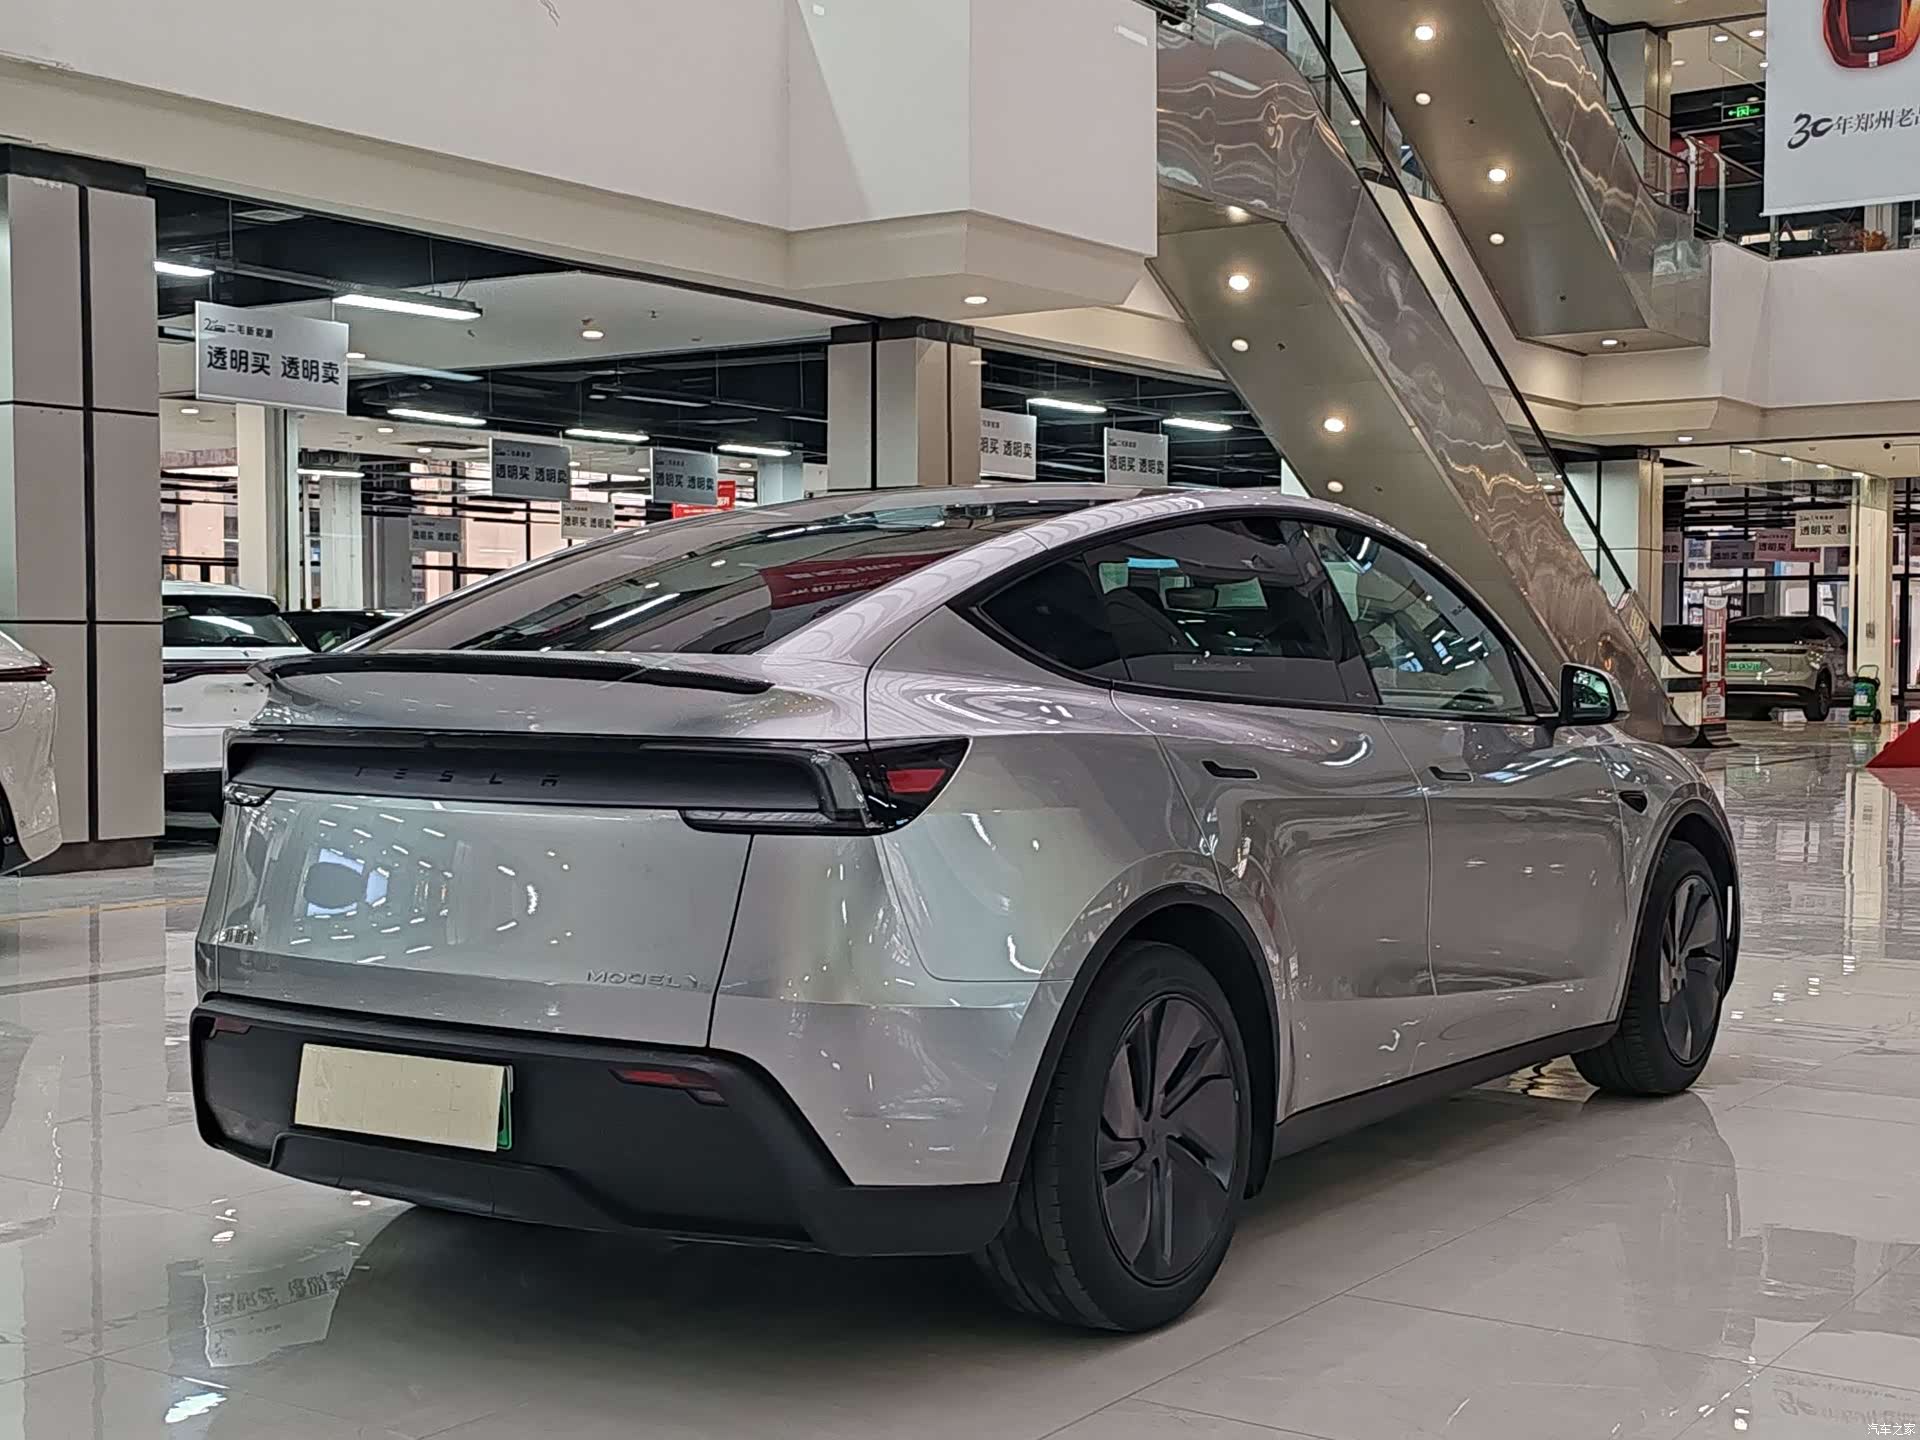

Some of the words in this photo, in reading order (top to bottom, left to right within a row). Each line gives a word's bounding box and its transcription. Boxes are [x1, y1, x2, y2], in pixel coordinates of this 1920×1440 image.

[207, 345, 271, 376] 透明买
[281, 355, 339, 385] 透明卖
[1003, 440, 1032, 459] 透明卖
[496, 464, 529, 480] 透明买
[535, 467, 567, 484] 透明卖
[1109, 455, 1135, 472] 透明买
[1139, 458, 1164, 475] 透明卖
[1800, 525, 1832, 535] 透明买
[355, 767, 560, 787] TESLA
[587, 969, 681, 989] MODEL
